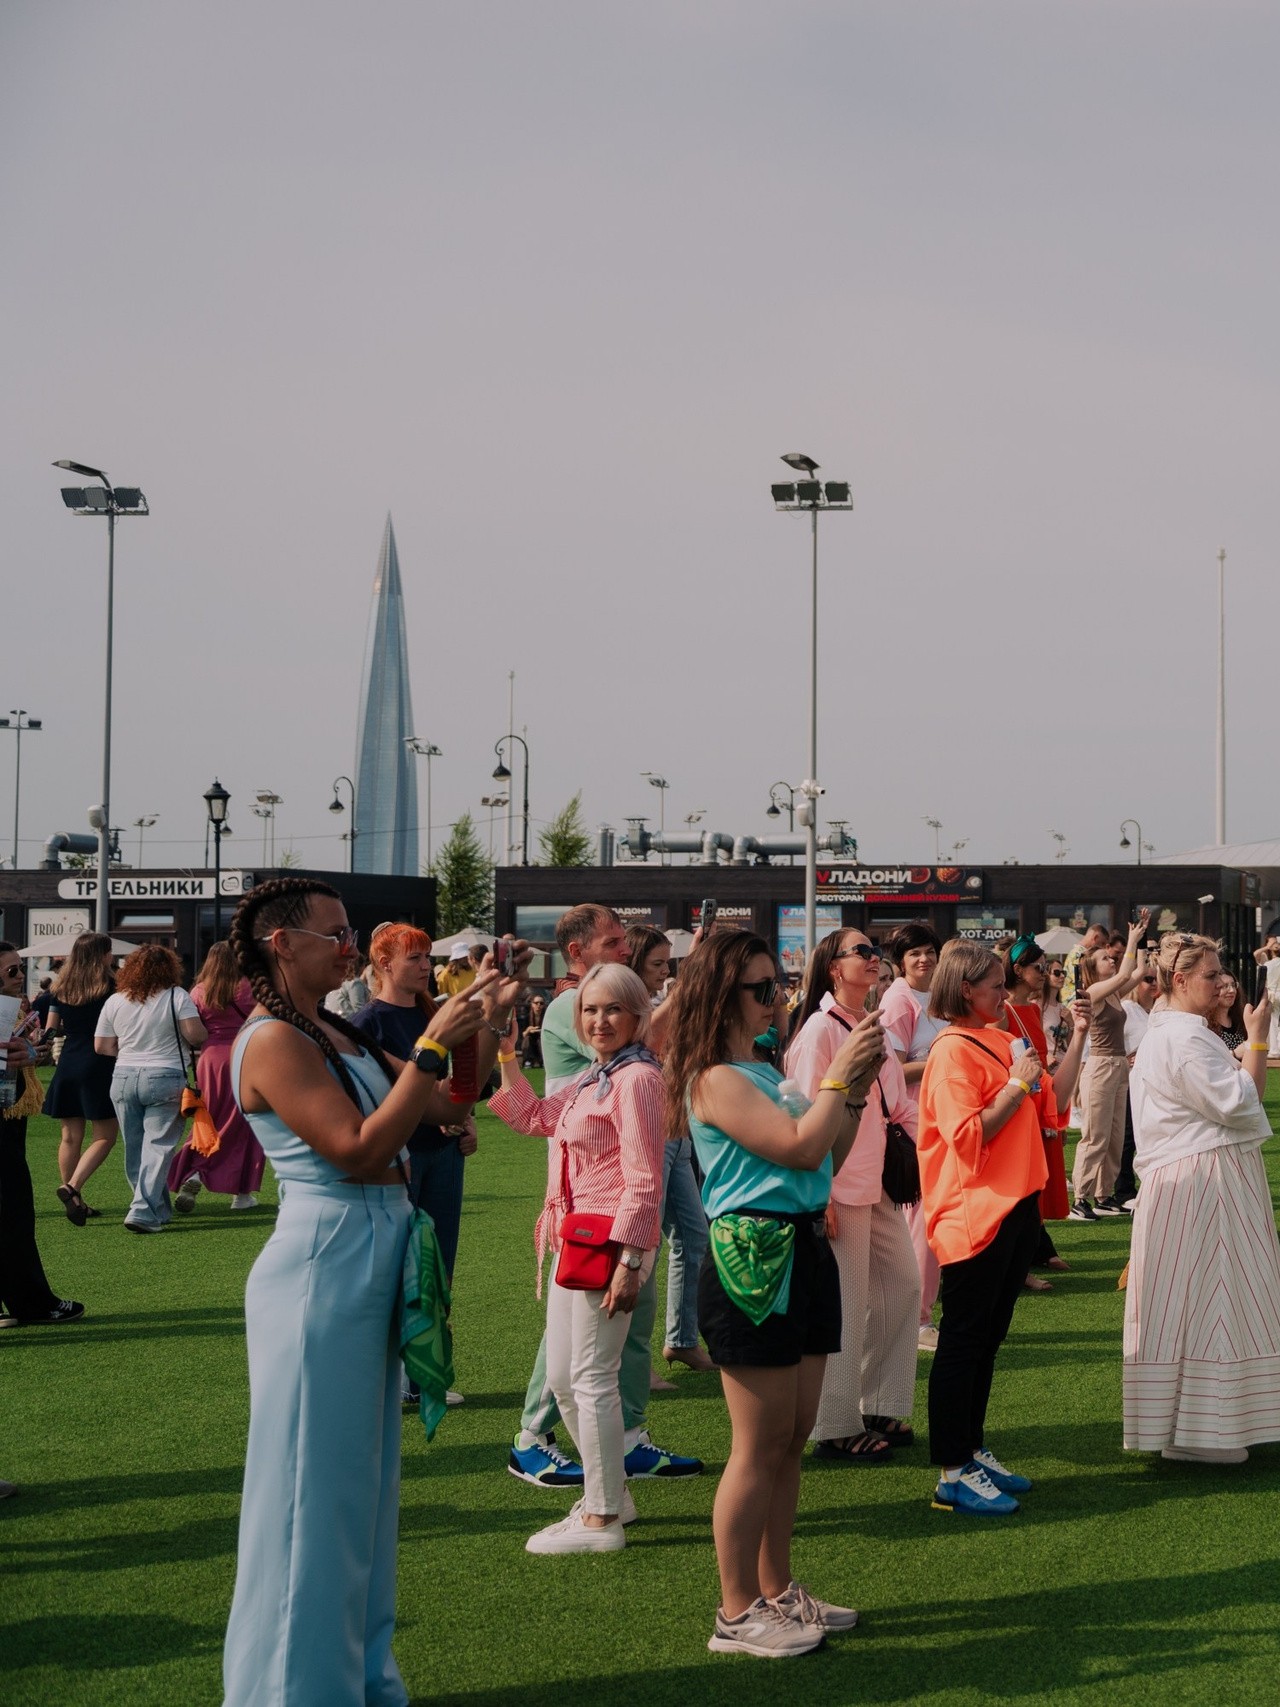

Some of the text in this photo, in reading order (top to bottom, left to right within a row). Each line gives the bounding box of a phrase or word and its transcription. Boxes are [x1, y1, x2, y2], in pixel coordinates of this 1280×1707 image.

[75, 881, 204, 896] ТРЕЛЬНИКИ
[815, 894, 865, 902] РЕСТОРАН
[690, 907, 752, 917] VДОНИ
[33, 923, 64, 936] TRDLO
[960, 929, 1017, 940] ХОТ-ДОГИ
